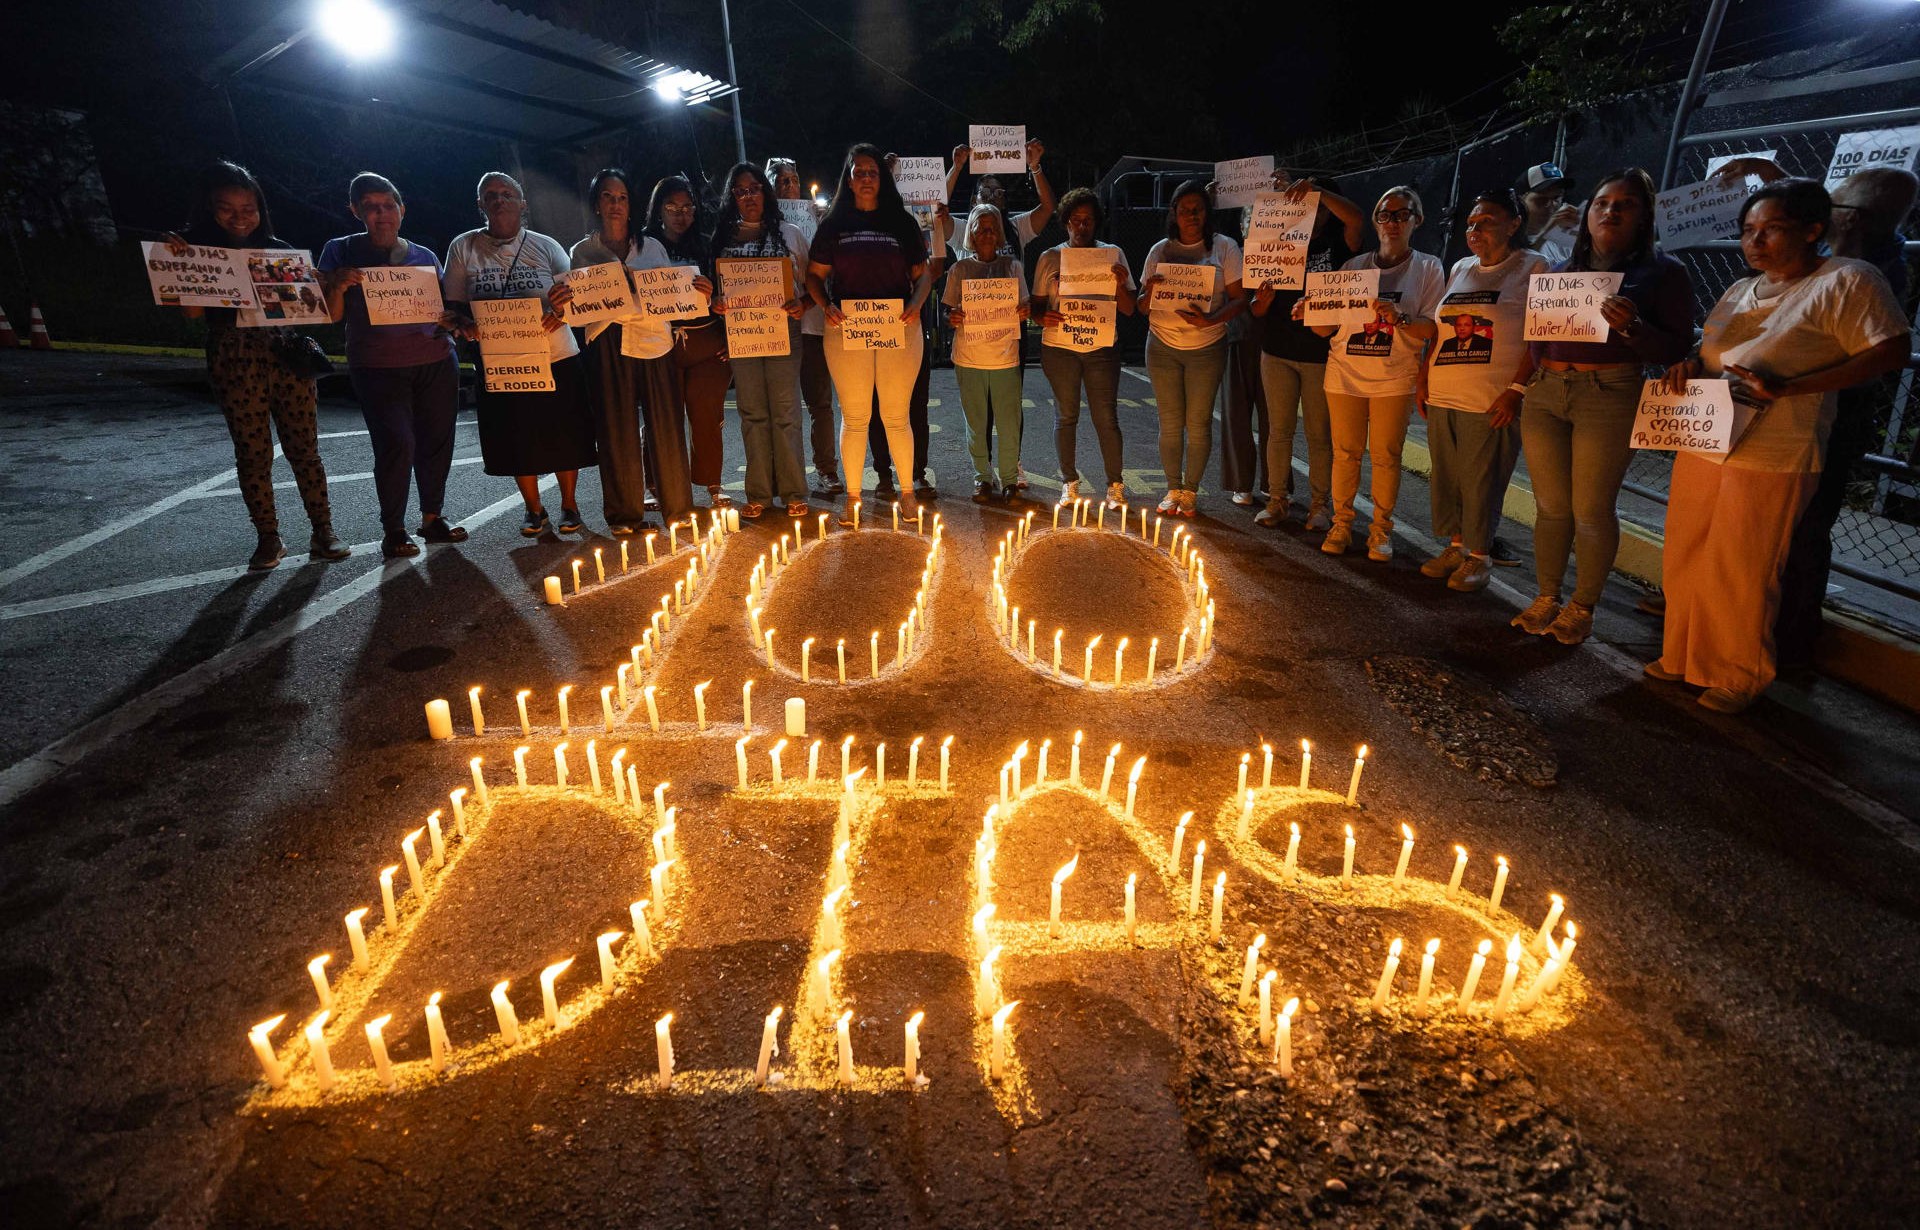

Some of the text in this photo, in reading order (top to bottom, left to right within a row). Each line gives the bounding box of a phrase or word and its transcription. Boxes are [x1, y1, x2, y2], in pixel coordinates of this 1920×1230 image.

[982, 126, 997, 136] 100
[1836, 143, 1912, 166] 100 DÍAS
[1832, 168, 1847, 177] DE
[1263, 199, 1277, 208] 100
[1659, 196, 1680, 209] 100
[1258, 209, 1307, 218] ESPERANDO
[1279, 230, 1310, 242] CAÑAS
[1260, 243, 1275, 253] 100
[1245, 255, 1296, 266] ESPERANDO
[1296, 256, 1305, 266] A
[150, 260, 236, 277] ESPERANDO A
[730, 264, 747, 275] 100
[1168, 265, 1184, 276] 100
[366, 271, 385, 283] 100
[476, 274, 496, 282] LOS
[566, 271, 585, 284] 100
[638, 271, 658, 285] 100
[723, 277, 780, 288] ESPERANDO A
[1322, 273, 1342, 285] 100
[571, 279, 613, 298] PERANDO
[967, 280, 982, 291] 100
[1535, 277, 1556, 293] 100
[366, 288, 412, 300] Esperando
[964, 292, 1015, 303] ESPERANDO A
[1308, 286, 1361, 298] ESPERANDO
[1361, 287, 1370, 297] A
[753, 294, 784, 307] GUERRA
[855, 301, 870, 312] 100
[1064, 301, 1079, 311] 100
[1528, 295, 1580, 312] Esperando
[484, 302, 506, 314] 100
[645, 302, 675, 317] Ricardo
[530, 315, 538, 325] A
[730, 311, 747, 322] 100
[845, 315, 885, 327] Esperando
[1529, 312, 1563, 336] Javier
[728, 326, 765, 337] Esperando
[1073, 333, 1095, 346] Rivas
[486, 365, 541, 375] CIERREN
[486, 382, 501, 391] EL
[504, 381, 546, 391] RODEO
[1640, 400, 1699, 418] Esperando
[1650, 418, 1713, 433] MARCO
